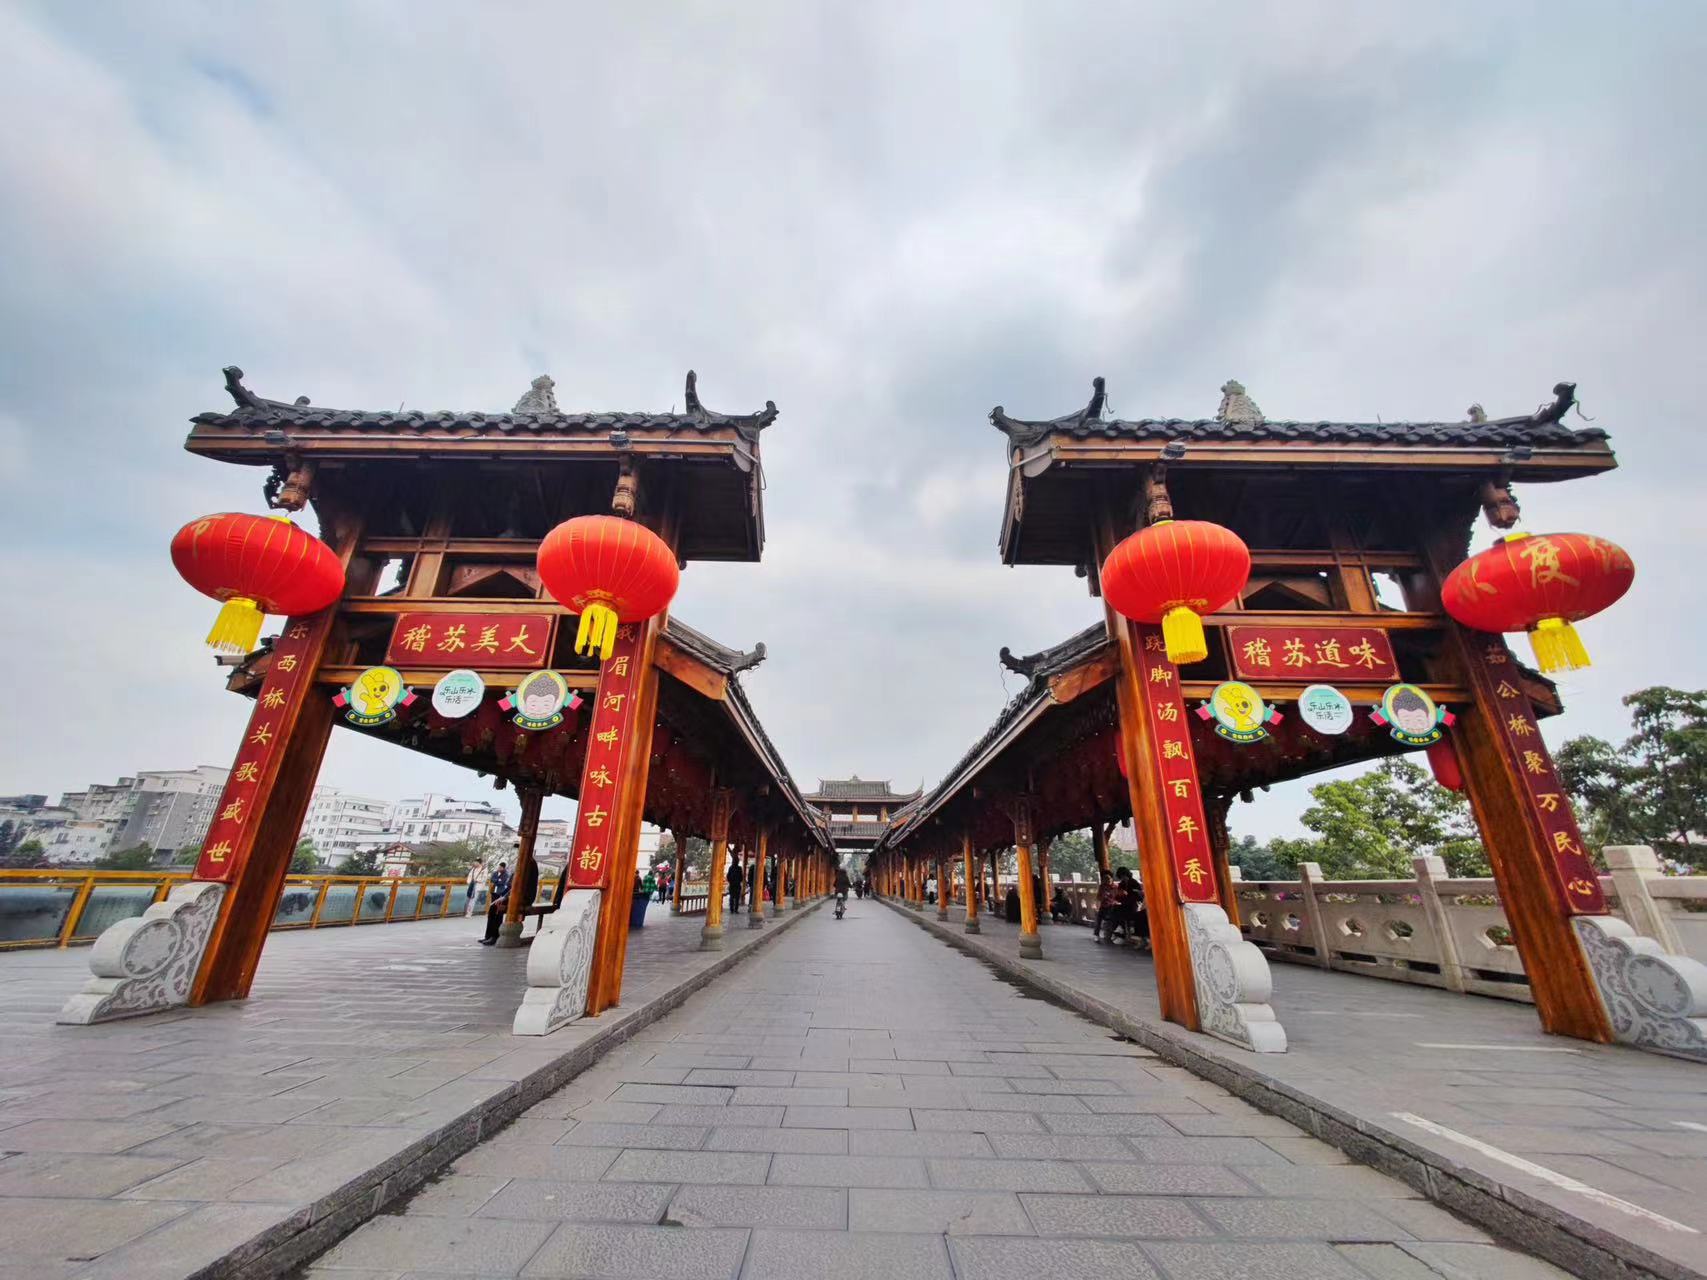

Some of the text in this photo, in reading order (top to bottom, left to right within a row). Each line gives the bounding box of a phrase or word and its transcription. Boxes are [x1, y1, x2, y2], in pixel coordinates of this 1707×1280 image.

[206, 624, 309, 862] 乐西桥头歌盛世
